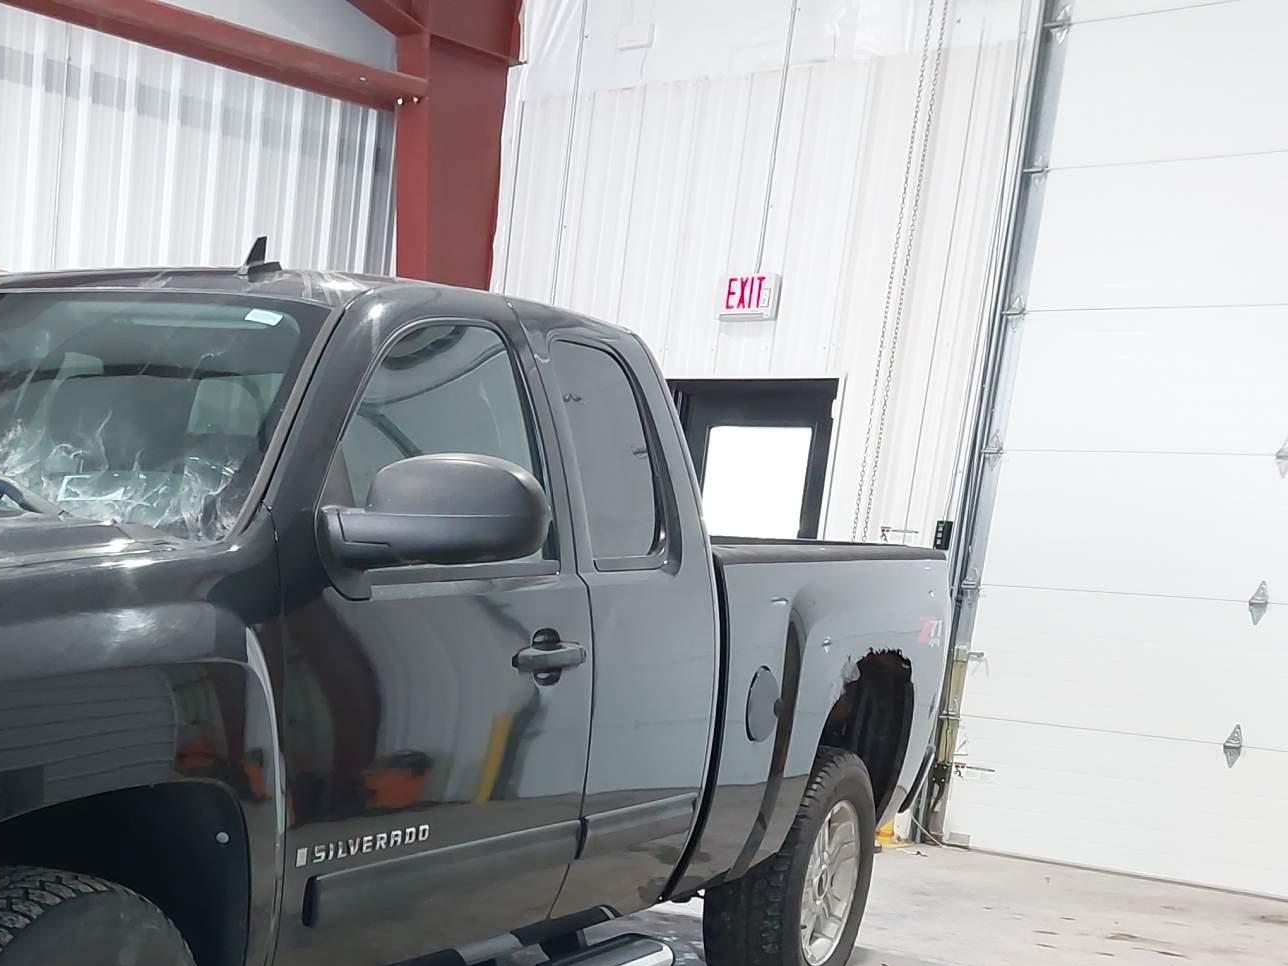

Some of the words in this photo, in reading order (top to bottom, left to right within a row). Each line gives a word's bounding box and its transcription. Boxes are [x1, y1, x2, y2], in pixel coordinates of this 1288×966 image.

[725, 277, 766, 309] EXIT
[918, 617, 942, 641] Z71
[312, 824, 430, 863] SILVERADO
